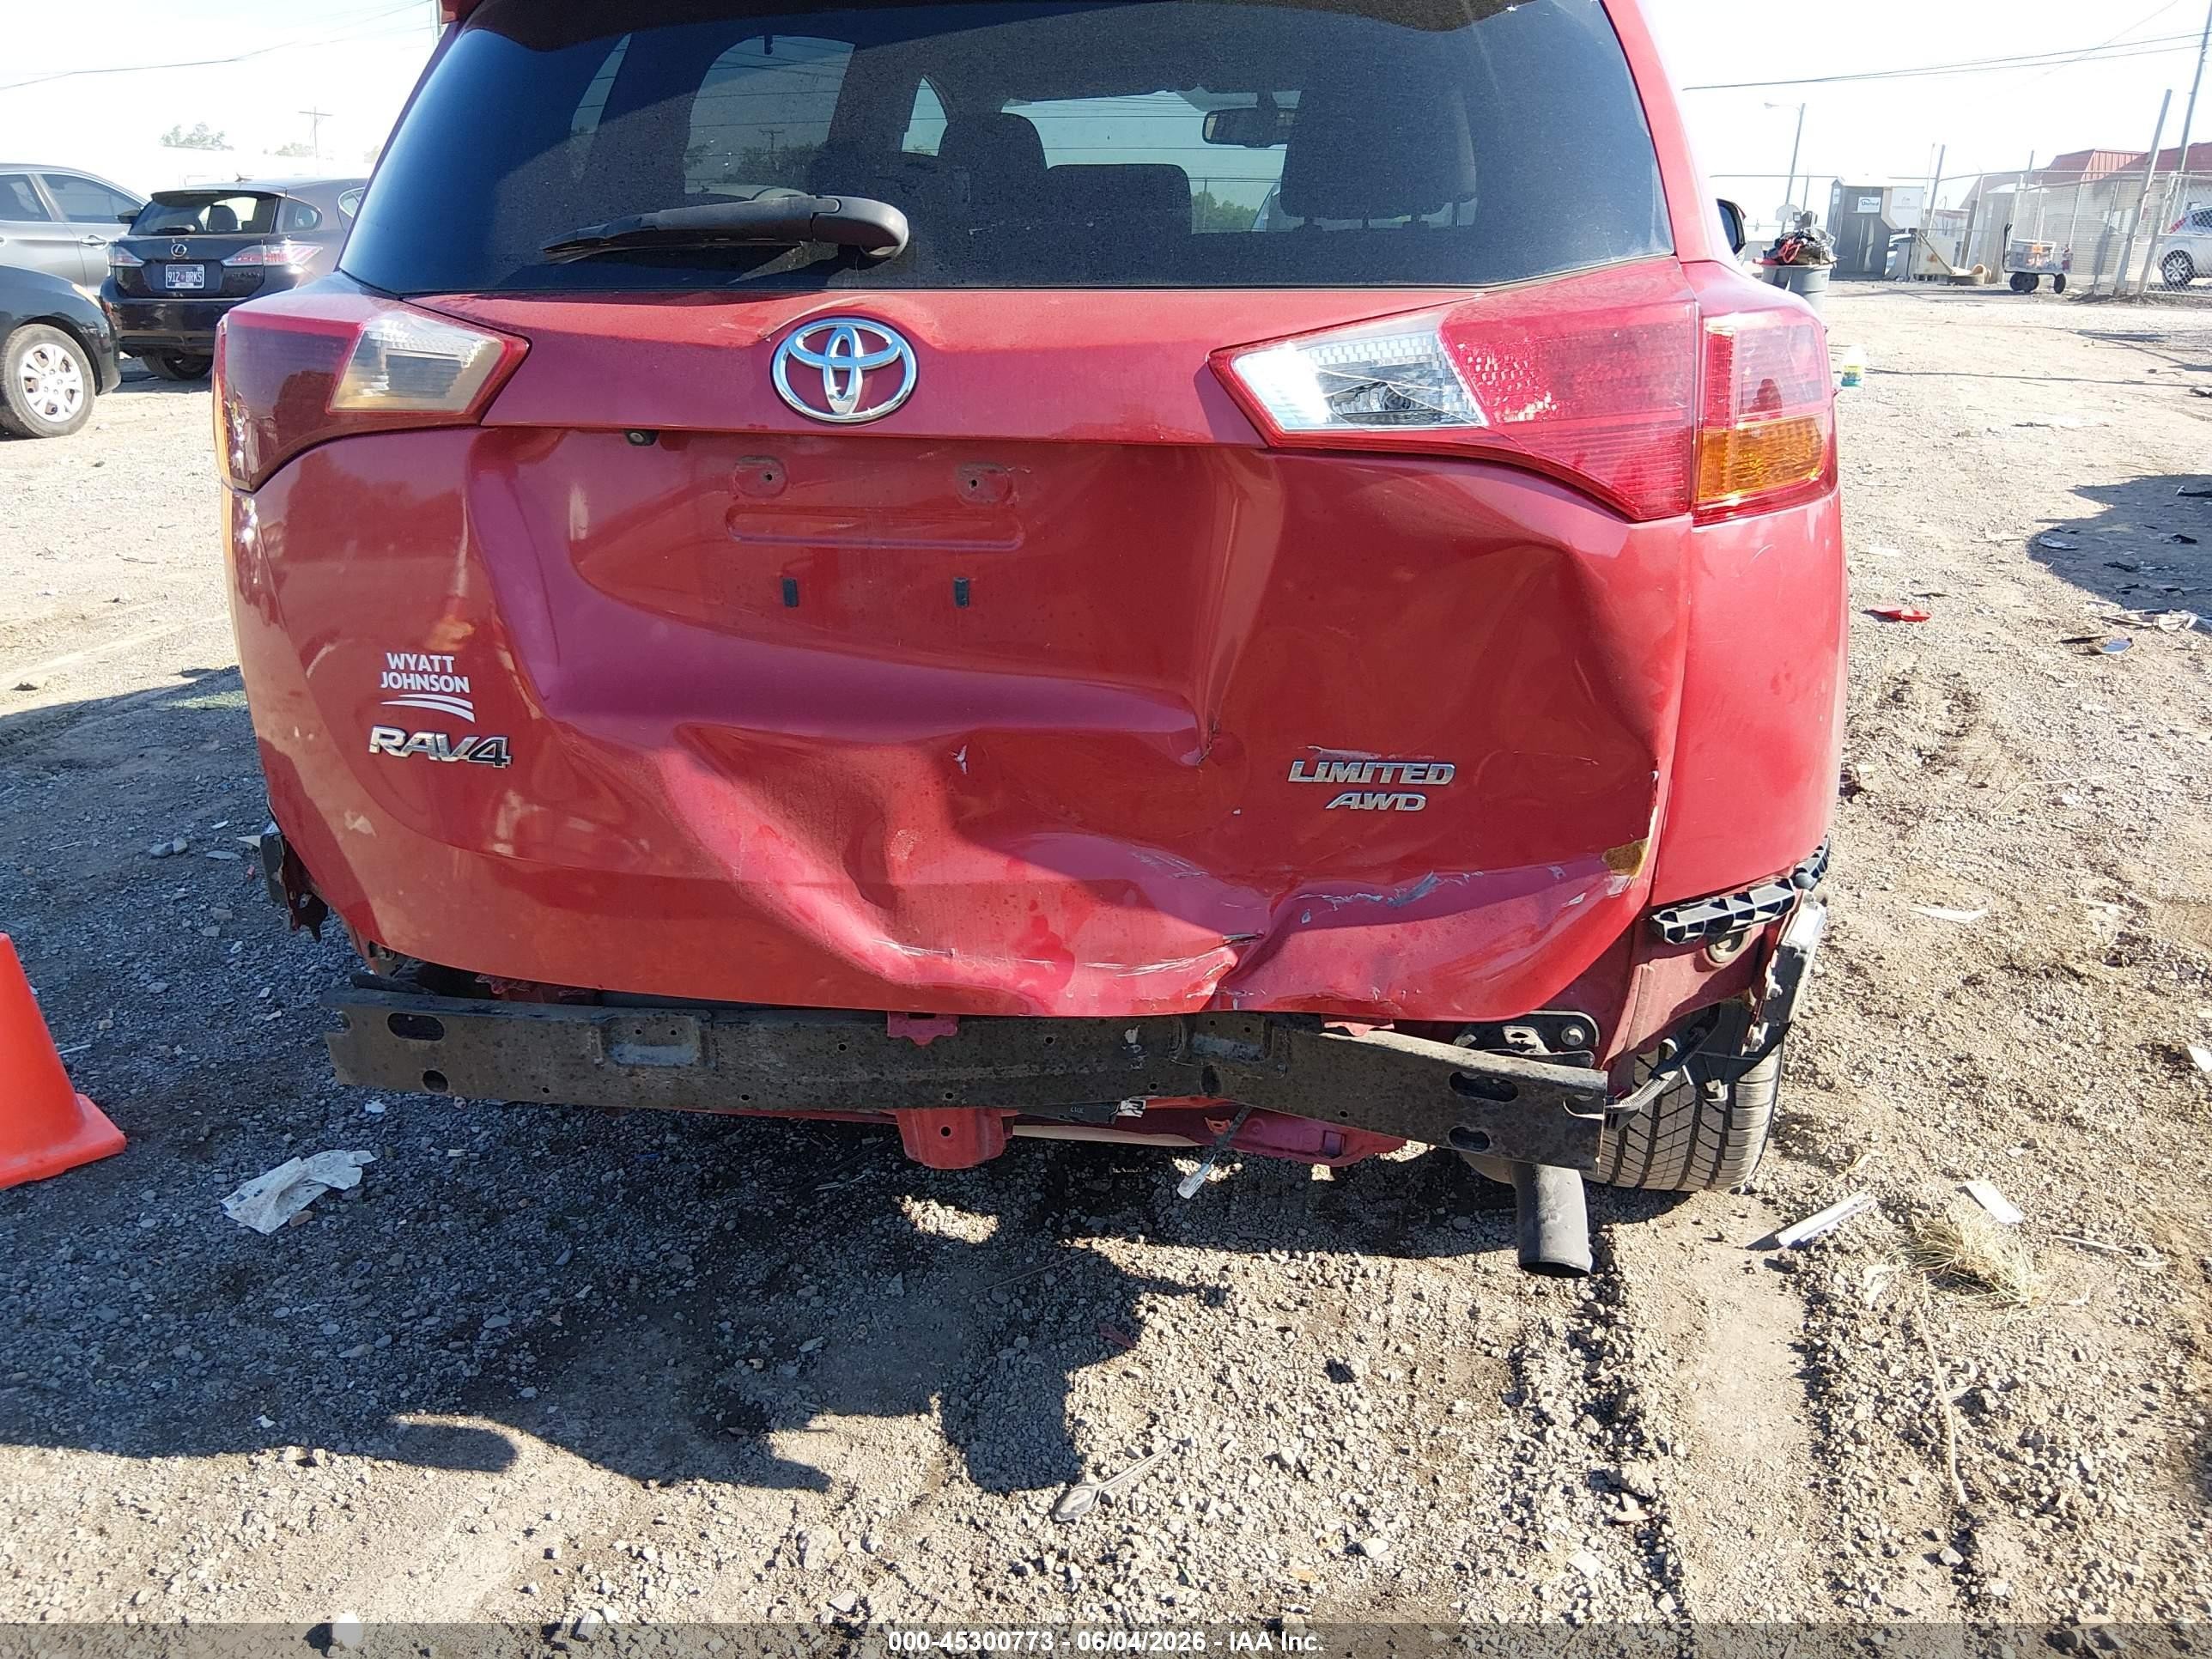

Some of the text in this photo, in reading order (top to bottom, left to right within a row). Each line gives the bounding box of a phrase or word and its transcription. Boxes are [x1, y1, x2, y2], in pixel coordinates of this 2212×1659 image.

[167, 271, 180, 283] 912
[385, 652, 455, 673] WYATT
[380, 672, 471, 694] JOHNSON
[368, 725, 513, 769] RAV4
[1287, 761, 1456, 786] LIMITED
[1325, 792, 1427, 811] AWD
